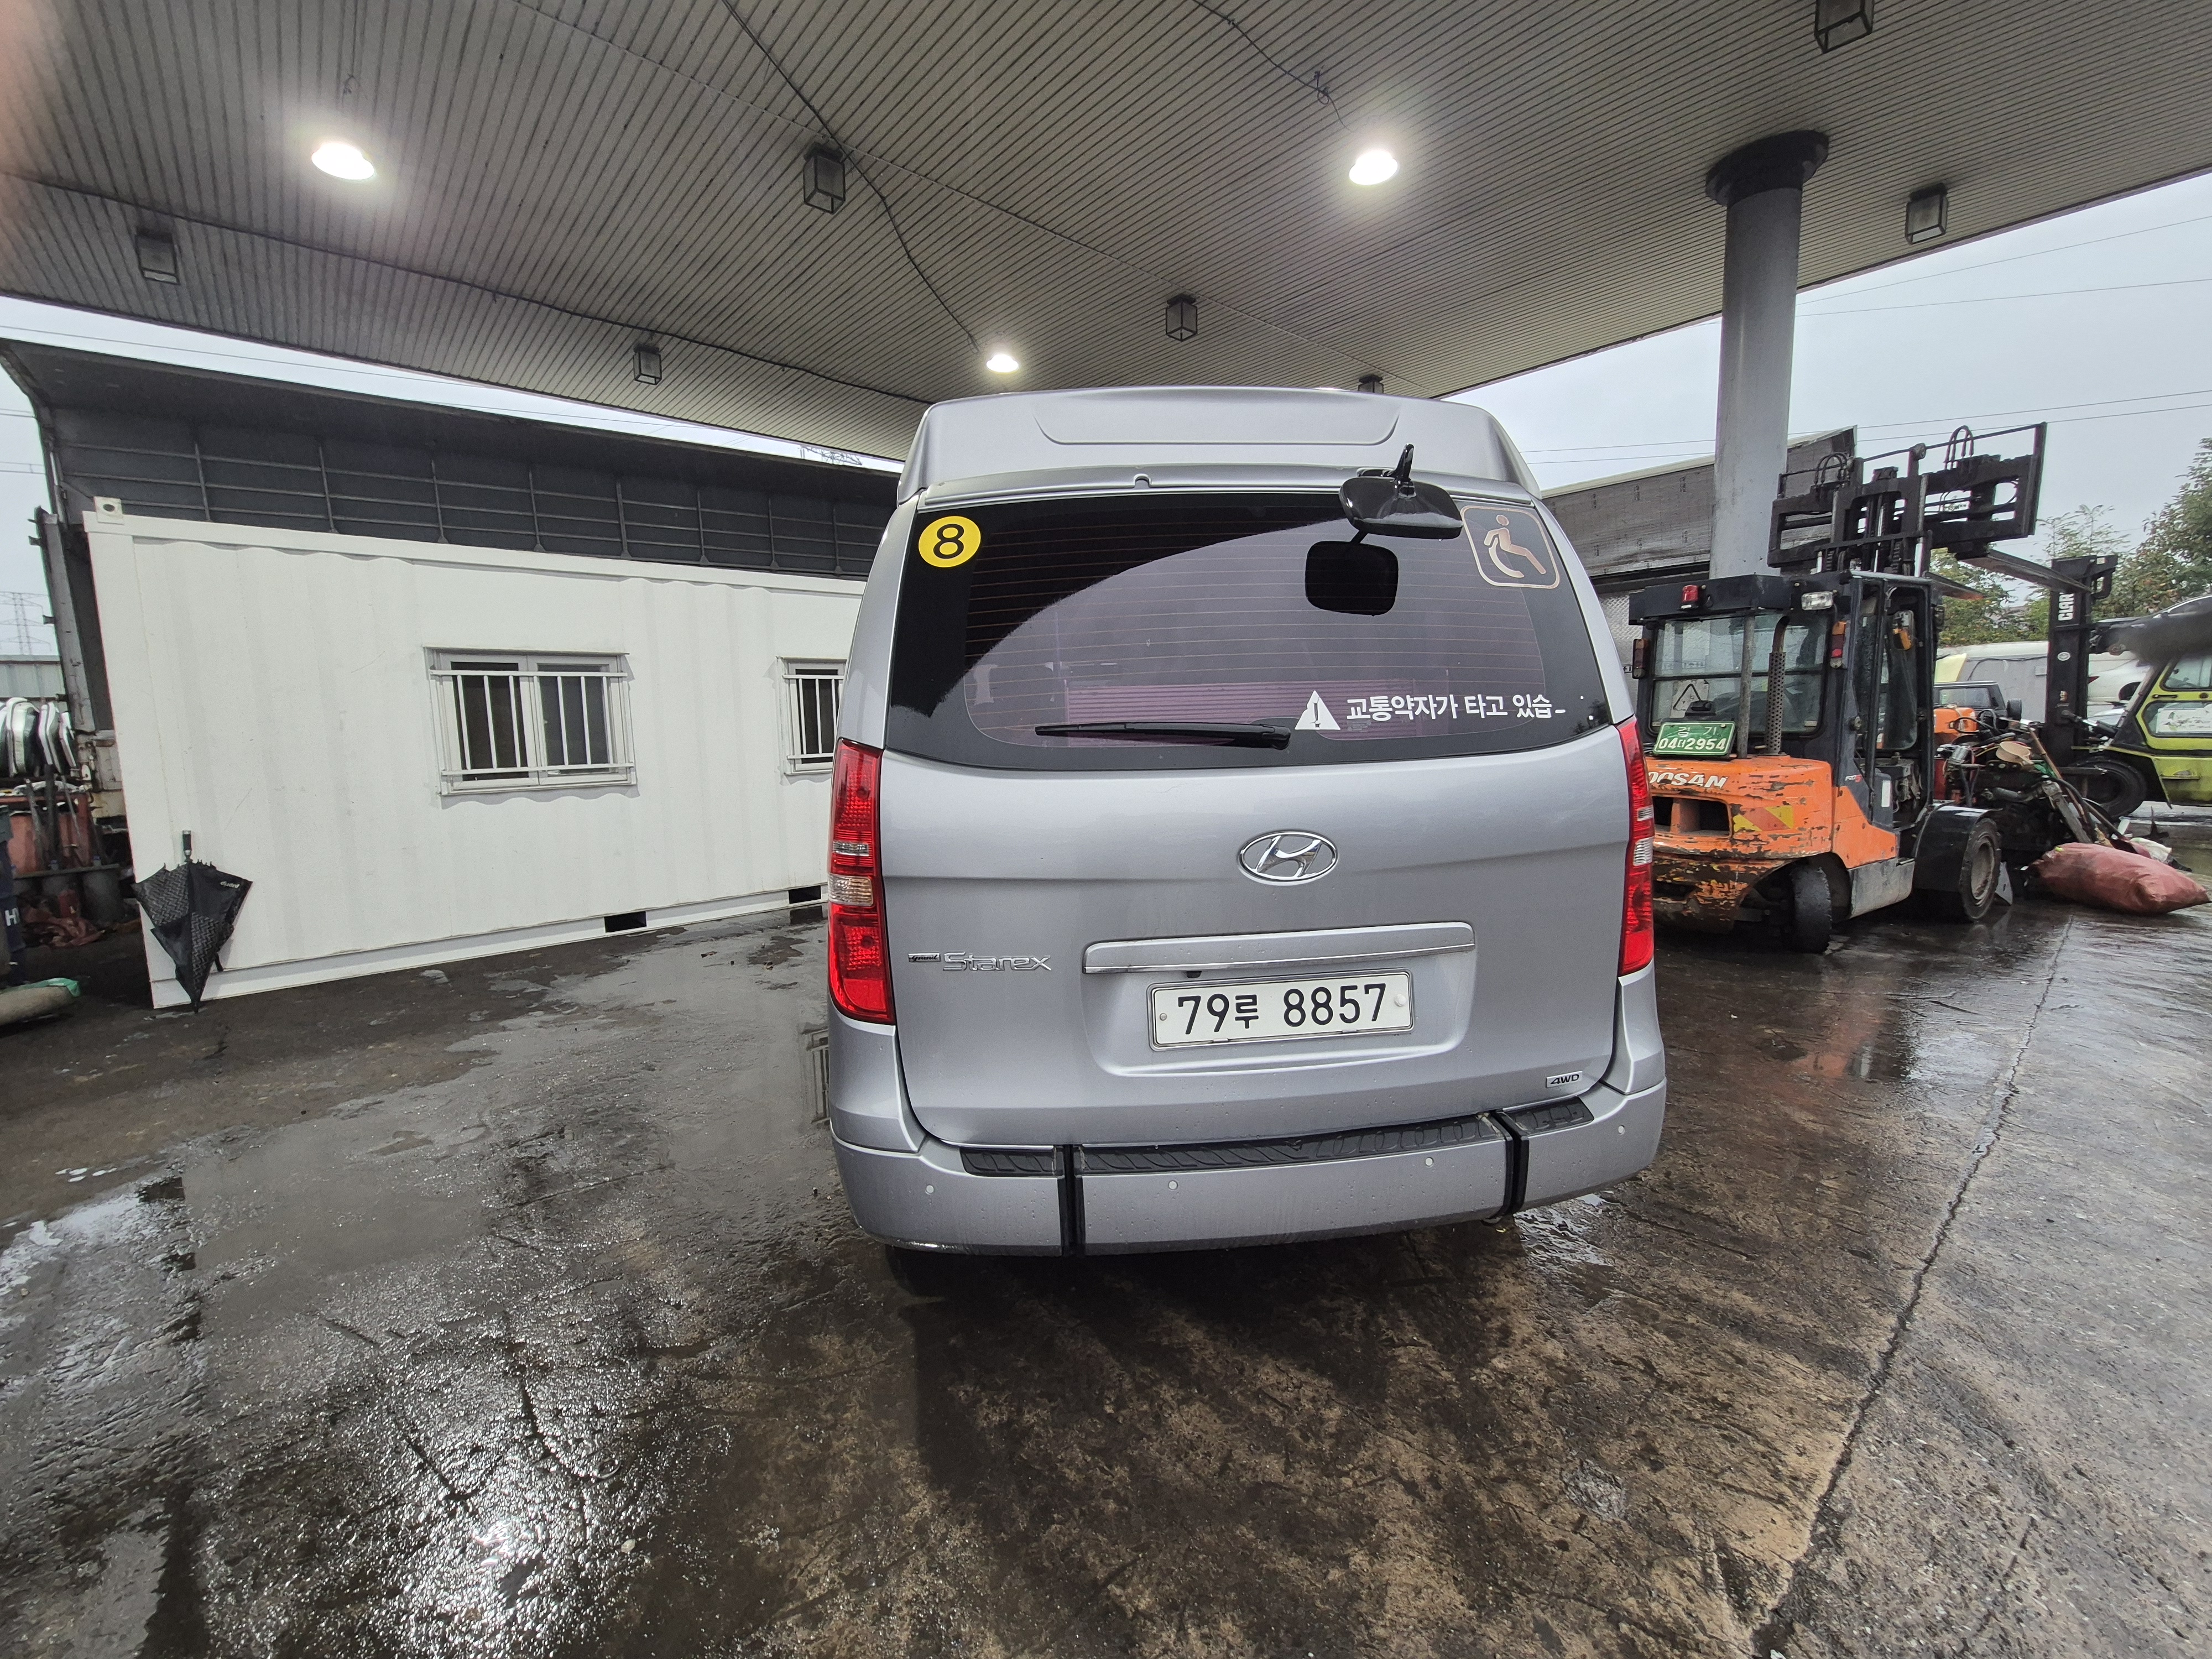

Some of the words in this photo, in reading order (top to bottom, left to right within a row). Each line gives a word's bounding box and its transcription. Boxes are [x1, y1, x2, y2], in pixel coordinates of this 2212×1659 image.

[933, 524, 964, 559] 8
[2057, 592, 2074, 621] CLAR
[1346, 694, 1458, 722] 교통약자가
[1464, 693, 1508, 718] 타고
[1512, 693, 1566, 718] 있습
[1648, 771, 1729, 789] OOSAN
[910, 954, 938, 962] Grand
[943, 951, 1052, 972] Starex
[1177, 993, 1259, 1035] 79루
[1283, 983, 1386, 1027] 8857
[1550, 1073, 1579, 1084] 4WD
